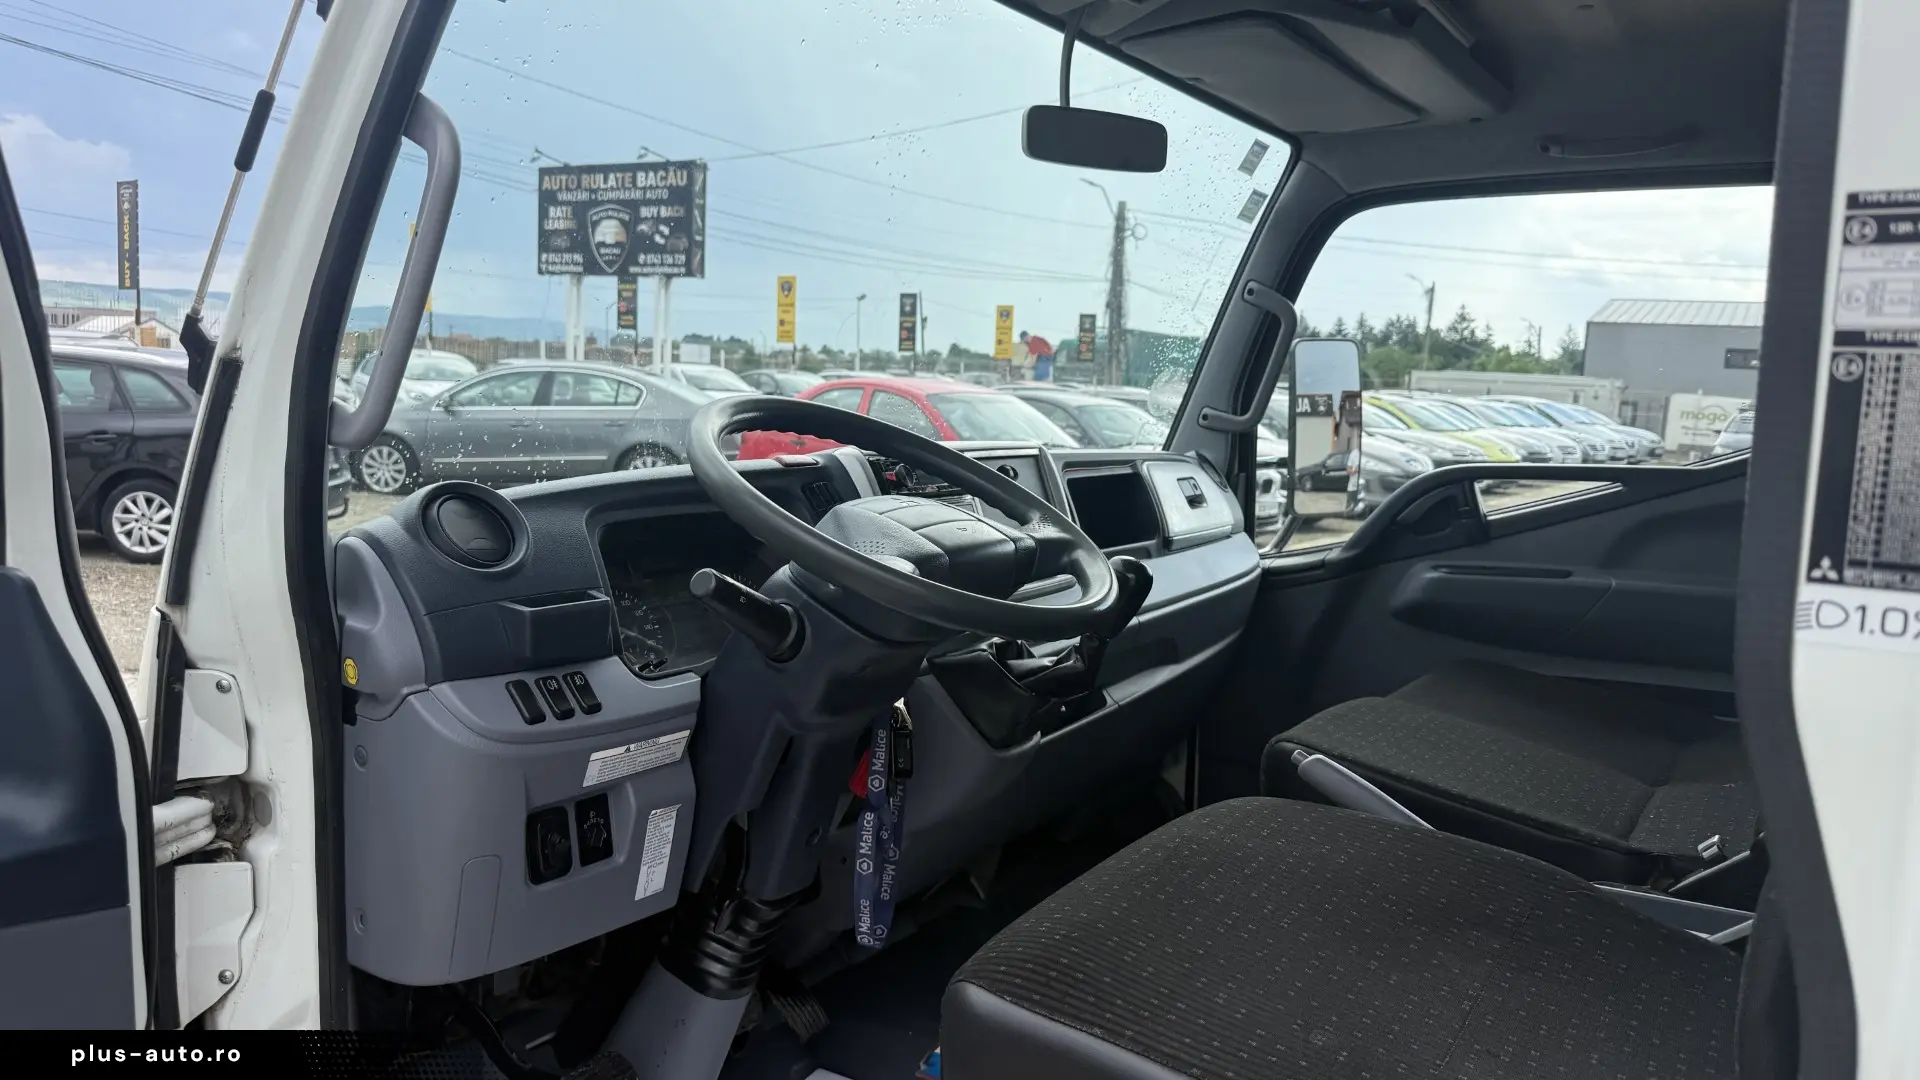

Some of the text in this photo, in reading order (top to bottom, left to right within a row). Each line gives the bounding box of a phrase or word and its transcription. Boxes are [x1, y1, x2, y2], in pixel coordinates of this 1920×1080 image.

[542, 167, 688, 191] AUTO RULATE BACĂU
[646, 188, 669, 200] AUTO
[549, 205, 574, 218] RATE
[639, 206, 659, 218] BUY
[1680, 410, 1728, 426] mogo
[1855, 603, 1920, 639] 1.0
[872, 729, 887, 771] Malice
[859, 811, 875, 854] Malice
[880, 863, 897, 901] Malice
[858, 898, 871, 933] Malice
